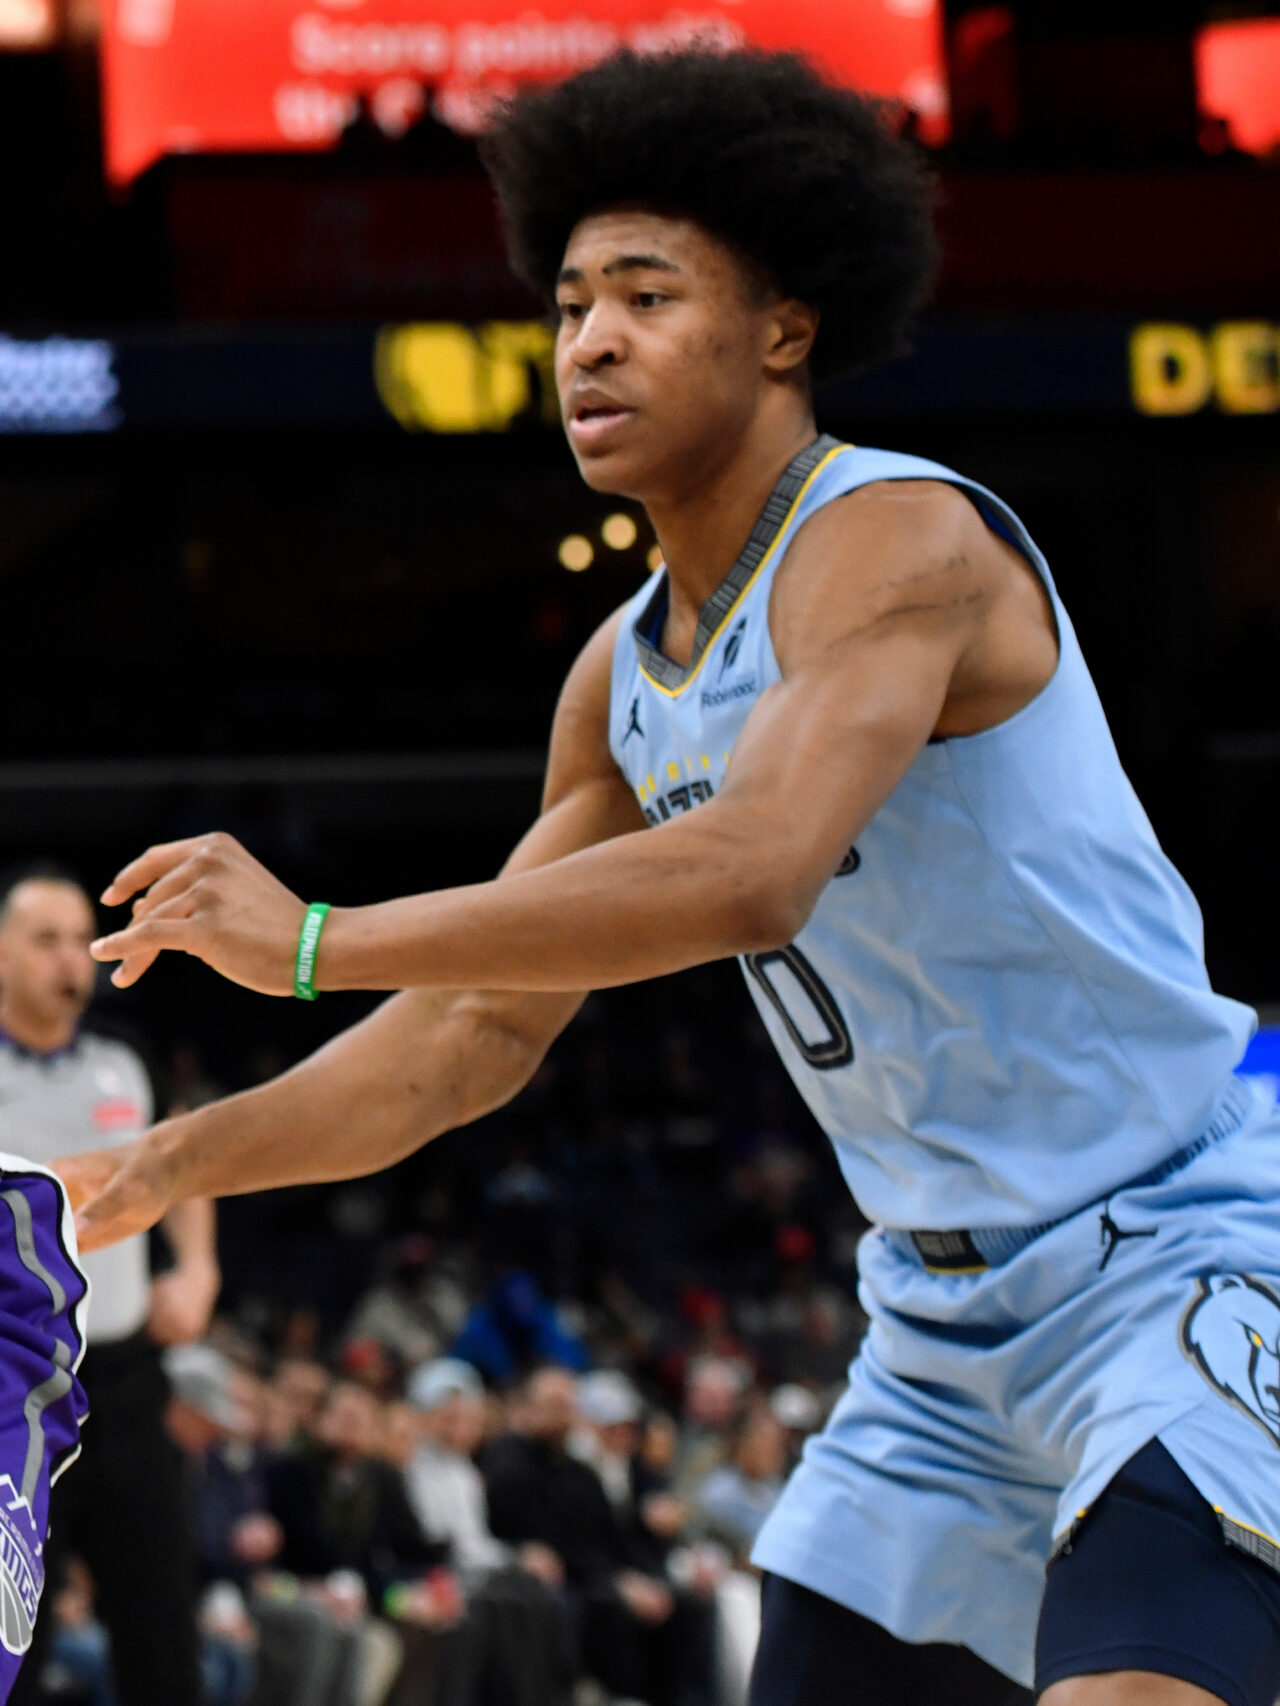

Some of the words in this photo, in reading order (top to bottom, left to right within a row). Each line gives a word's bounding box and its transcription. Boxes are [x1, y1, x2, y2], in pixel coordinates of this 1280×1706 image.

[290, 12, 450, 75] Score
[456, 12, 619, 97] points
[746, 944, 855, 1071] 0
